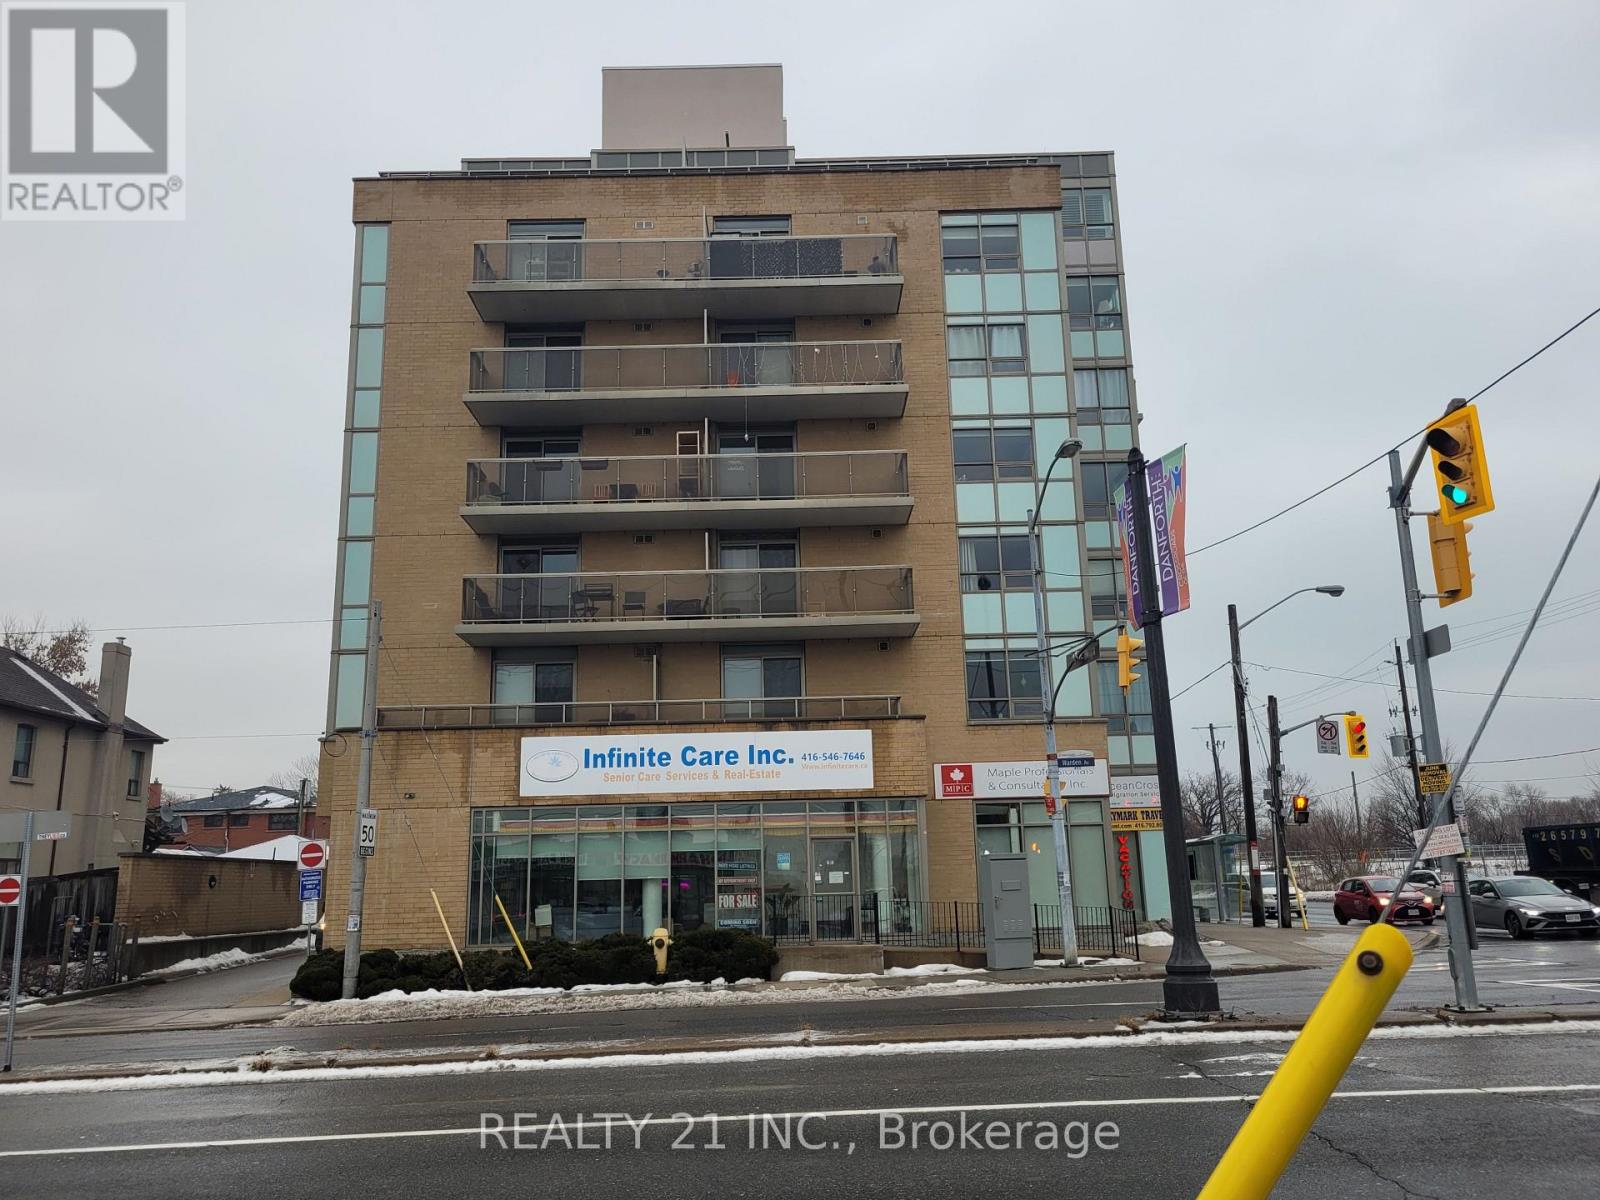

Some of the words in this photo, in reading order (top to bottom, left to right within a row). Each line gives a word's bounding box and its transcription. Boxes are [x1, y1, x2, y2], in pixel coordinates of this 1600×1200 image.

[1151, 480, 1175, 582] DANFORTH
[584, 746, 672, 769] Infinite
[680, 745, 739, 767] Care
[748, 744, 795, 765] Inc.
[801, 751, 866, 762] 416-546-7646
[603, 772, 636, 783] Senior
[638, 771, 661, 782] Care
[666, 769, 709, 781] Services
[712, 769, 719, 780] &
[724, 768, 781, 780] Real-Estate
[987, 768, 1022, 778] Maple
[988, 781, 996, 790] &
[361, 824, 375, 843] 50
[719, 895, 735, 909] FOR
[737, 894, 757, 908] SALE
